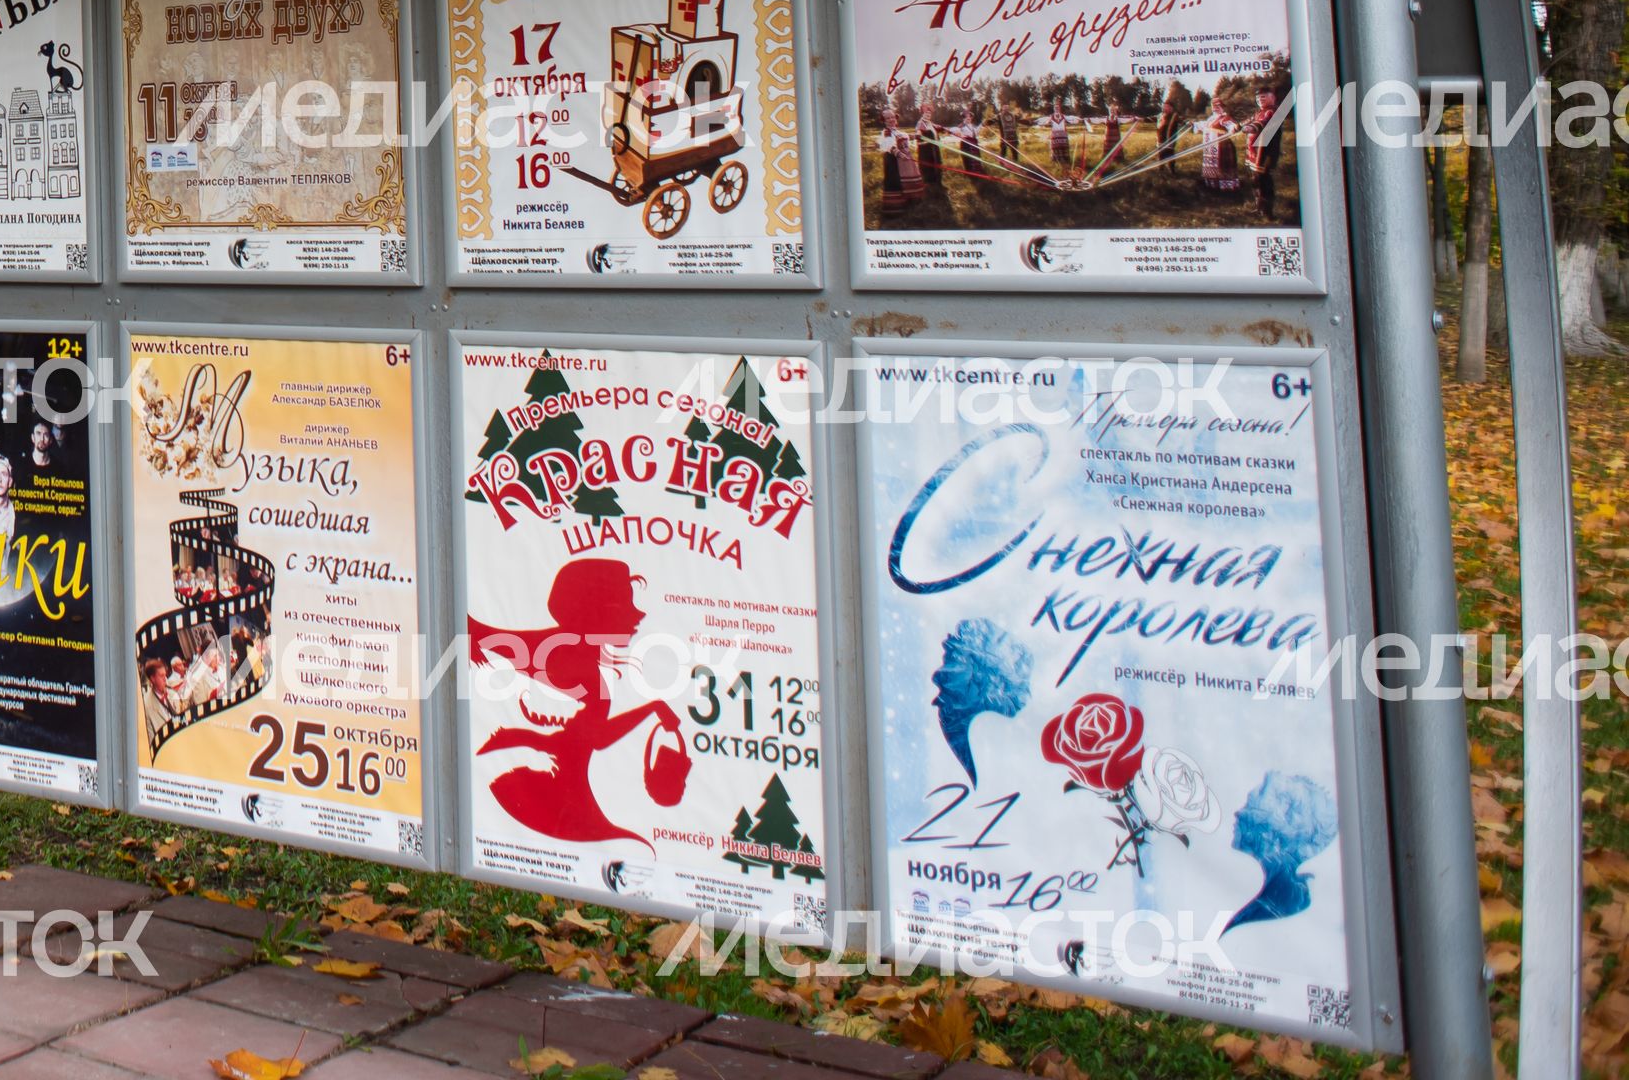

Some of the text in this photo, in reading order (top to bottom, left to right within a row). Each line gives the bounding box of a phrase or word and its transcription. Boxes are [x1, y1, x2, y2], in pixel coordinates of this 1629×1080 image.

[165, 0, 264, 44] новых
[509, 21, 562, 66] 17
[1145, 31, 1251, 45] главный хормейстер:
[1129, 43, 1270, 59] Заслуженный артист России
[1130, 58, 1271, 76] Геннадий Шалунов
[494, 64, 587, 103] октября
[186, 174, 351, 188] режиссёр Валентин ТЕПЛЯКОВ
[516, 201, 569, 215] режиссёр
[503, 218, 585, 231] Никита Беляев
[876, 248, 983, 259] Щёлковский театр
[48, 338, 82, 359] 12+
[131, 340, 411, 366] www.tkcentre.ru 6+
[464, 352, 808, 383] www.tkcentre.ru 6+
[280, 382, 371, 396] главный дирижёр
[875, 364, 1313, 401] www.tkcentre.ru 6+
[272, 394, 381, 409] Александр БАЗЕЛЮК
[305, 424, 349, 436] дирижёр
[506, 386, 775, 449] Премьера сезона!
[280, 435, 378, 450] Виталий АНАНЬЕВ
[1079, 446, 1296, 471] спектакль по мотивам сказки
[1086, 470, 1293, 497] Ханса Кристиана Андерсена
[248, 500, 371, 535] сошедшая
[1112, 495, 1266, 519] «Снежная королева»
[562, 515, 743, 569] ШАПОЧКА
[325, 594, 357, 606] хиты
[664, 592, 818, 617] спектакль по мотивам сказки
[284, 610, 401, 634] из отечественных
[705, 615, 775, 633] Шарля Перро
[1029, 584, 1322, 689] королева
[1114, 664, 1316, 699] режиссёр Никита Беляев
[283, 691, 406, 720] духового оркестра
[249, 714, 418, 788] 25 октября
[693, 731, 820, 771] октября
[900, 782, 1021, 850] 21
[652, 825, 822, 867] режиссёр Никита Беляев
[907, 858, 1001, 891] ноября
